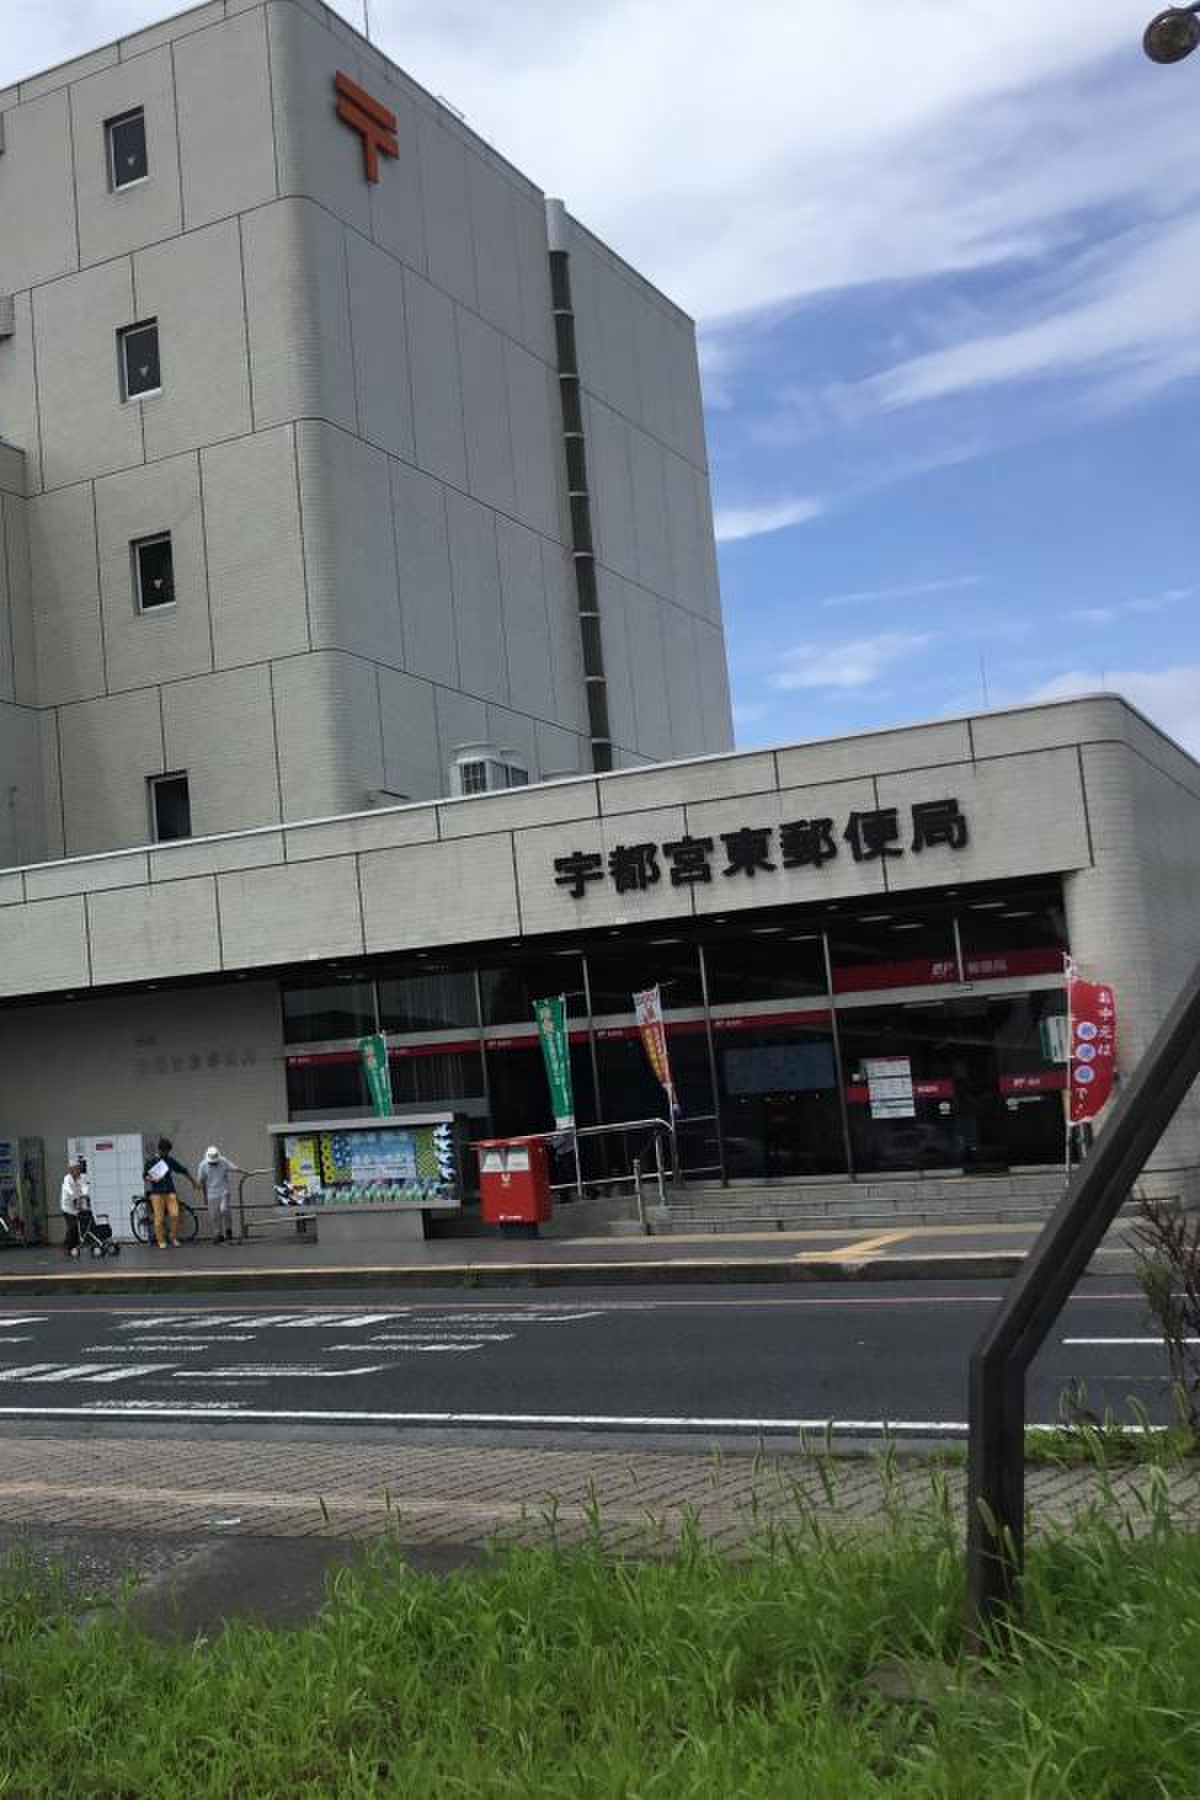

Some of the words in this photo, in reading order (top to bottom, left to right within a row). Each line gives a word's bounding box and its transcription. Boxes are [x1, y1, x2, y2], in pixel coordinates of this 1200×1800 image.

[554, 798, 968, 898] 宇都宮東郵便局
